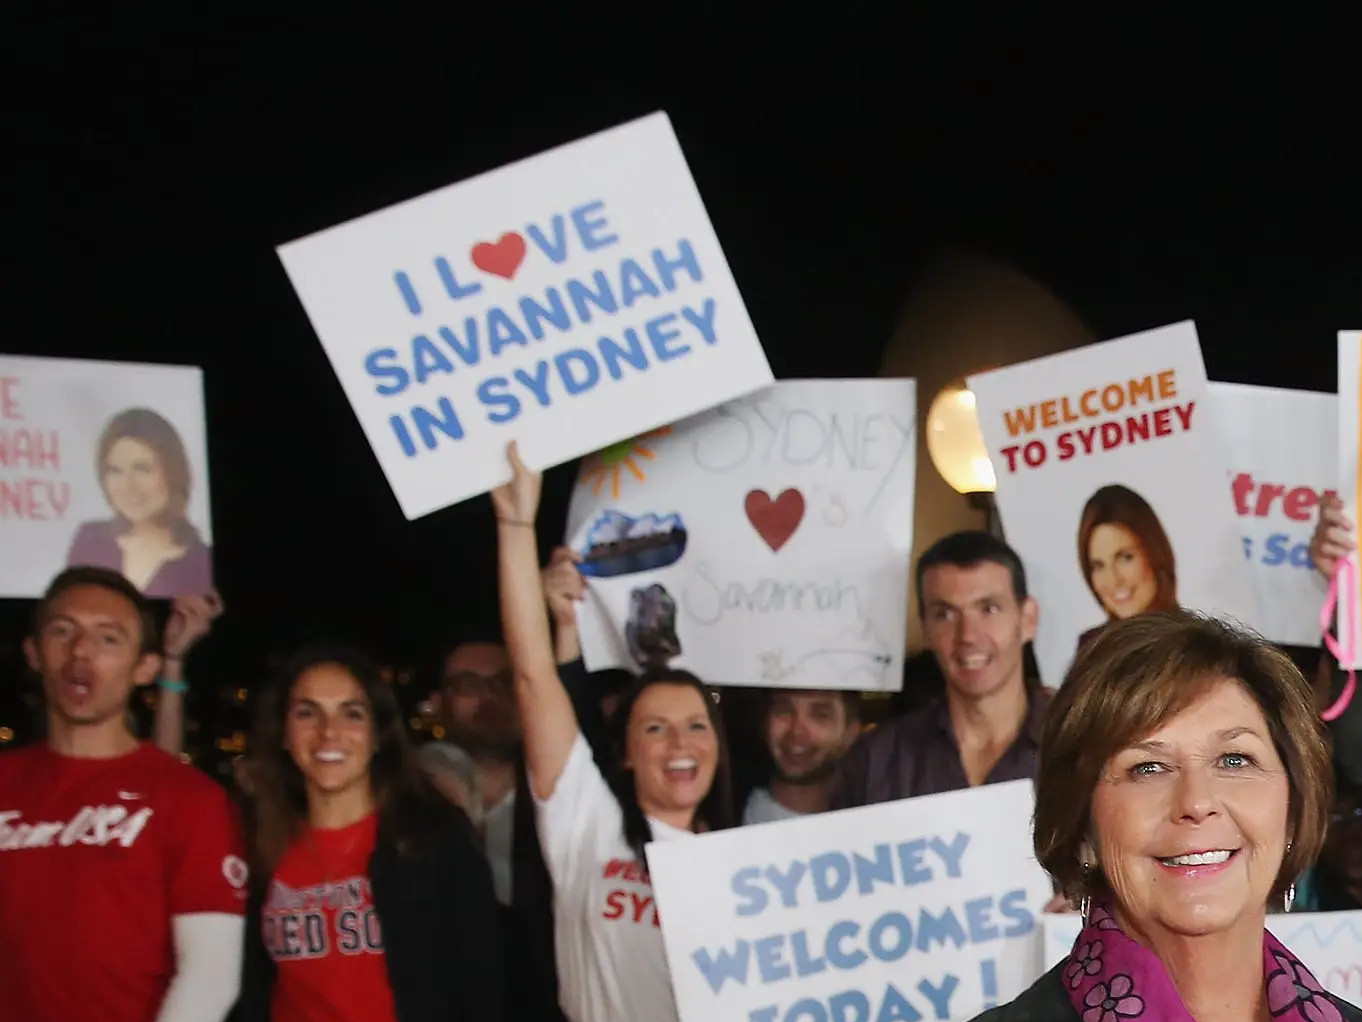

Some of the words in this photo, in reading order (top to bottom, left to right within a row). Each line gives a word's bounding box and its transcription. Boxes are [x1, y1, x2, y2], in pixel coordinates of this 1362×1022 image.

[363, 237, 705, 397] SAVANNAH
[394, 270, 422, 316] I
[389, 396, 465, 458] IN
[476, 297, 719, 425] SYDNEY
[1003, 368, 1178, 437] WELCOME
[1001, 441, 1048, 473] TO
[1056, 401, 1196, 461] SYDNEY
[1231, 472, 1338, 521] tre
[602, 889, 664, 929] SY
[730, 831, 972, 917] SYDNEY
[690, 888, 1035, 995] WELCOMES
